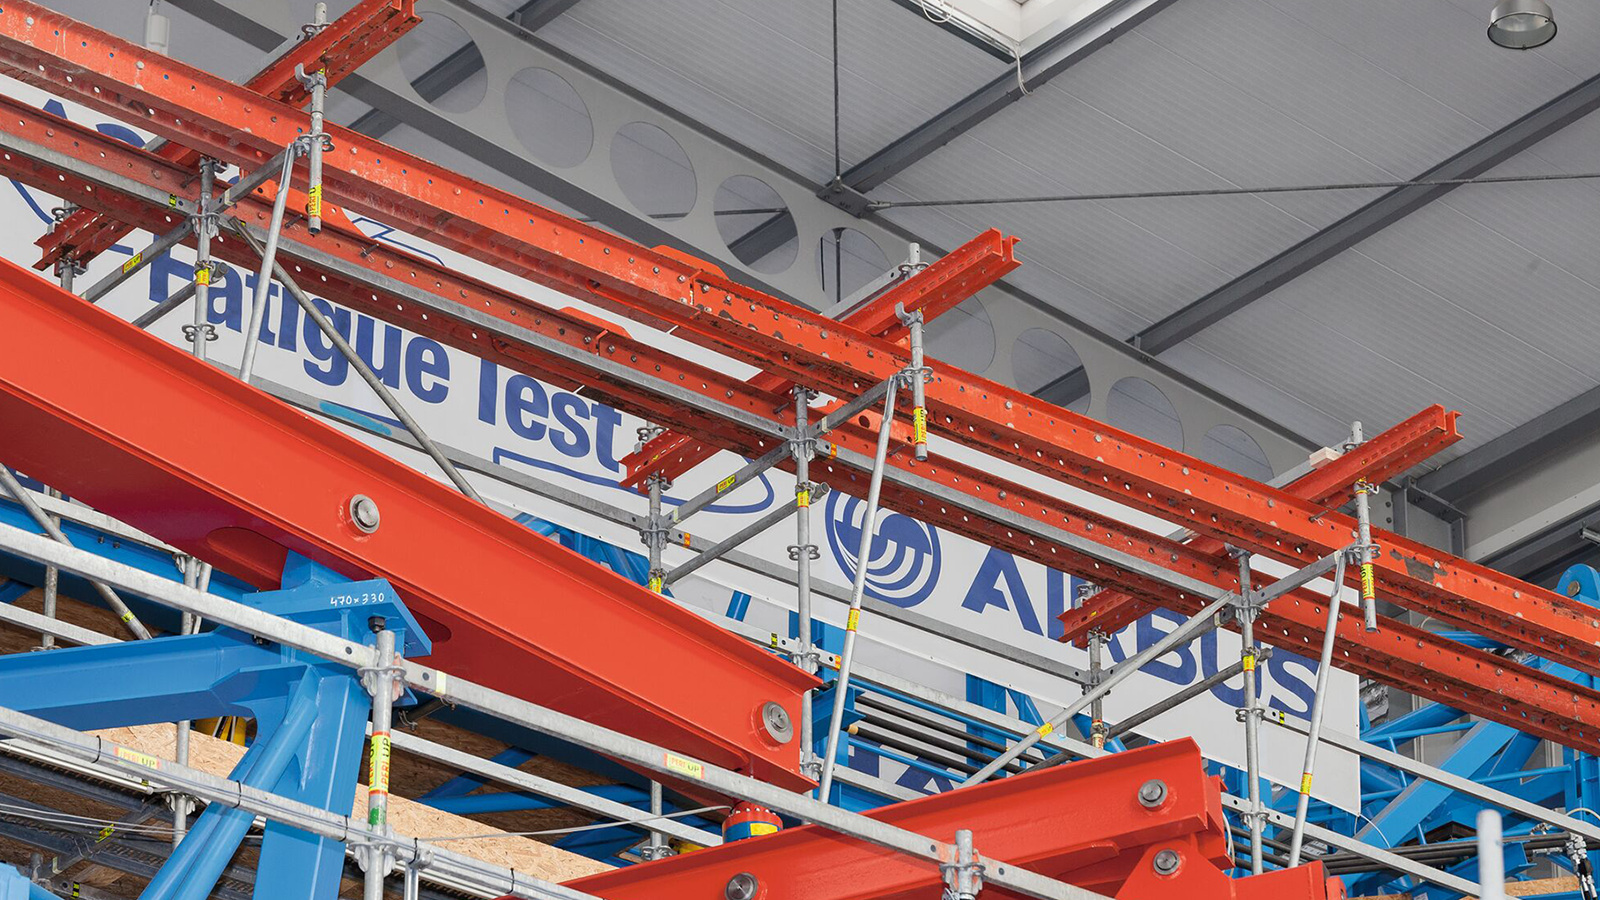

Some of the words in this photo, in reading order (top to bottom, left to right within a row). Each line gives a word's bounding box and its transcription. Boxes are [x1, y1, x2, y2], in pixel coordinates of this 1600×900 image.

[478, 357, 622, 474] Test
[382, 737, 390, 758] UP
[141, 757, 156, 768] UP
[381, 760, 389, 785] PERI
[687, 763, 700, 772] UP
